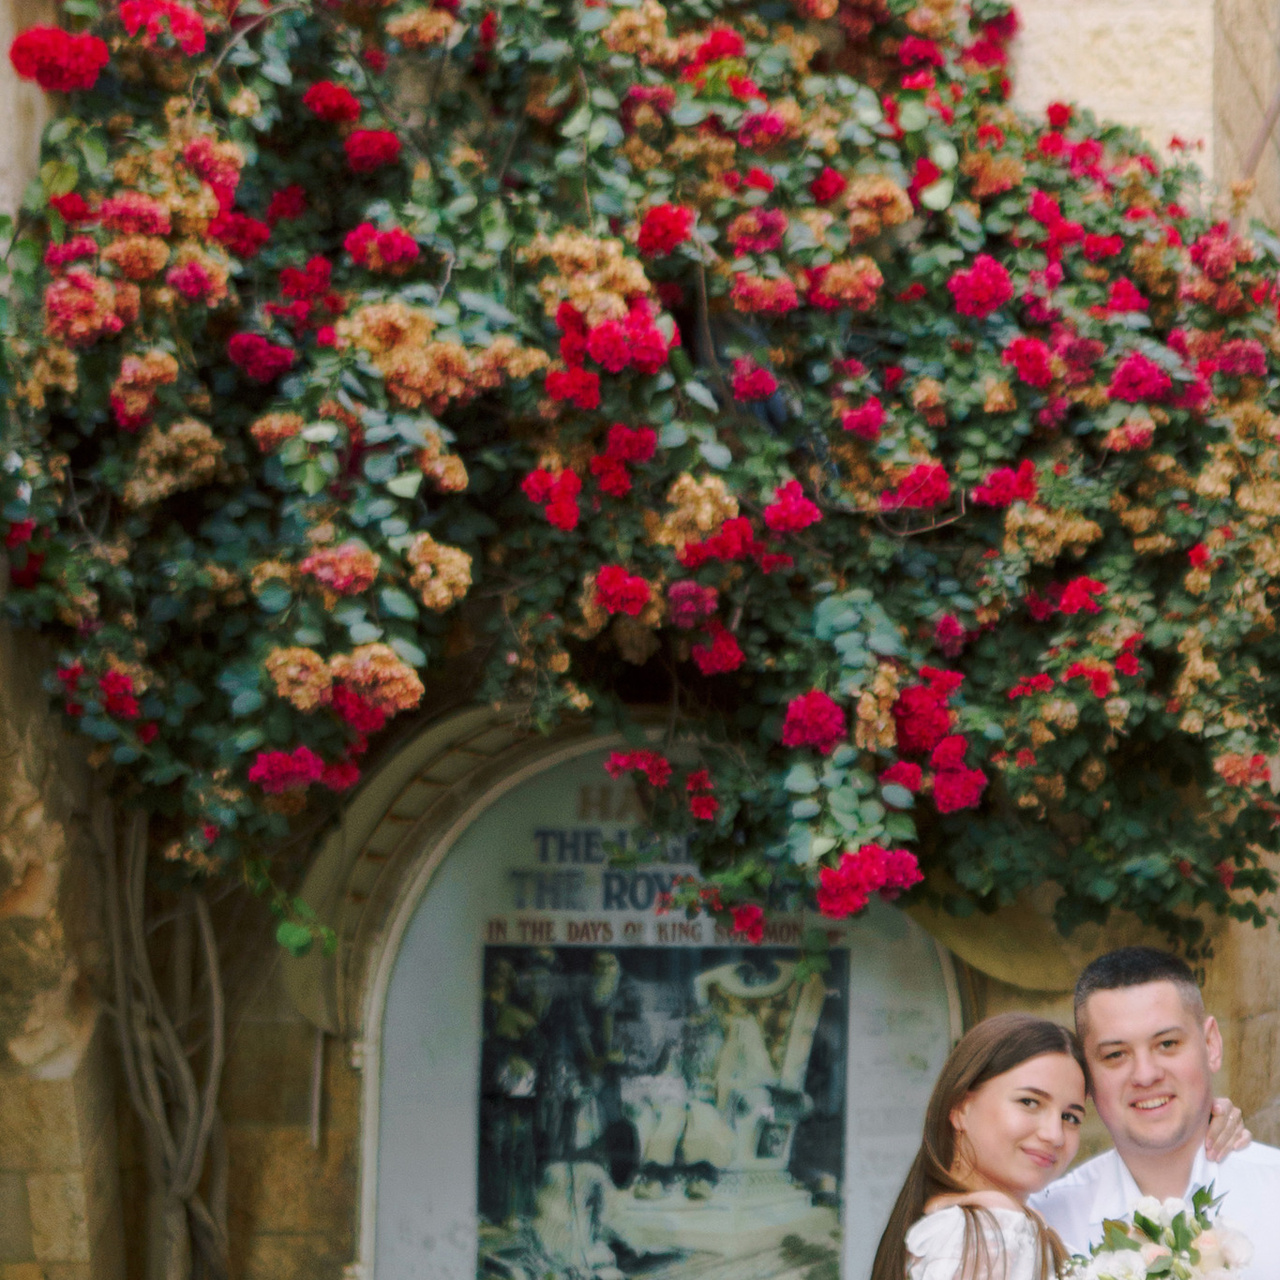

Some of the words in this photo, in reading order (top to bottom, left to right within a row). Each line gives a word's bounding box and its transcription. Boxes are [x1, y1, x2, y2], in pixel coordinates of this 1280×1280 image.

[534, 829, 605, 864] THE
[510, 870, 583, 910] THE
[487, 920, 508, 942] IN
[518, 920, 555, 942] THE
[567, 920, 613, 942] DAYS
[656, 921, 702, 943] KING
